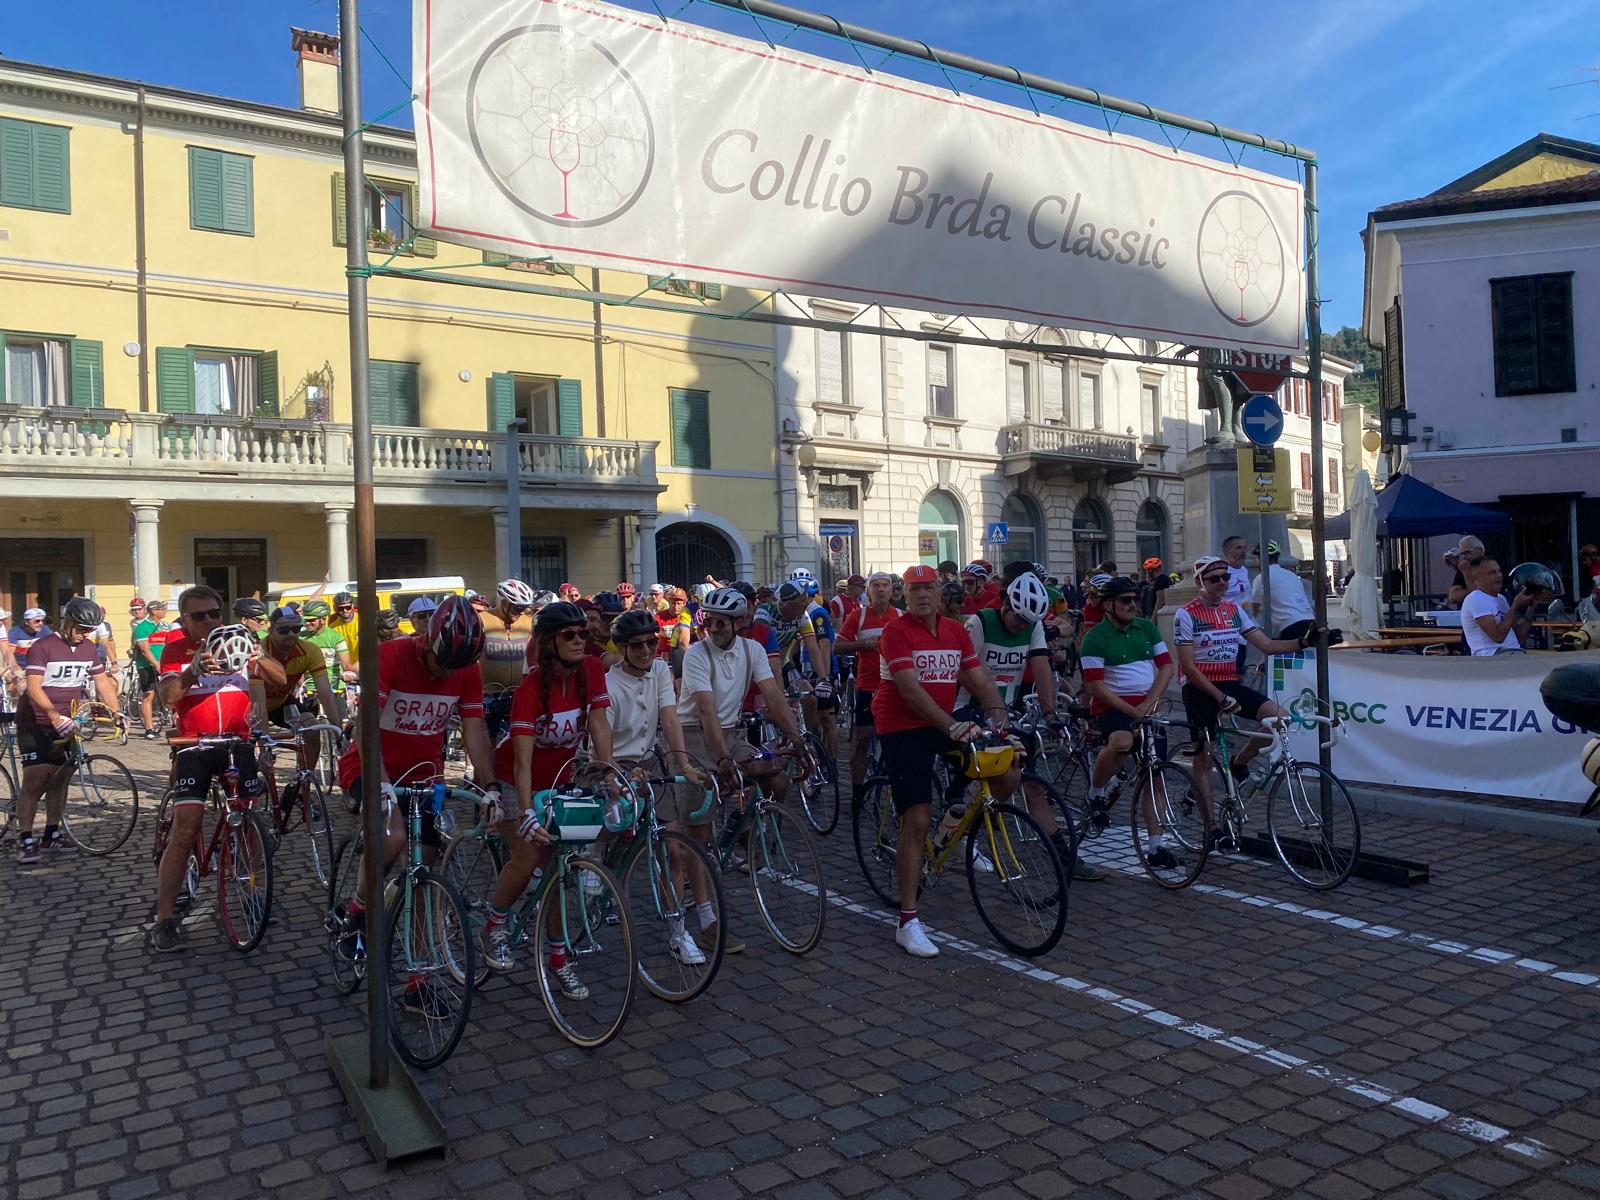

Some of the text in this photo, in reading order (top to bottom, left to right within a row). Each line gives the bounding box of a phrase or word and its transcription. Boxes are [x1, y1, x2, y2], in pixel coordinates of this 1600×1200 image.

[701, 128, 1170, 270] Collio Brda Classic
[986, 650, 1028, 665] PUCH
[1332, 700, 1388, 725] BCC
[1405, 704, 1542, 733] VENEZIA
